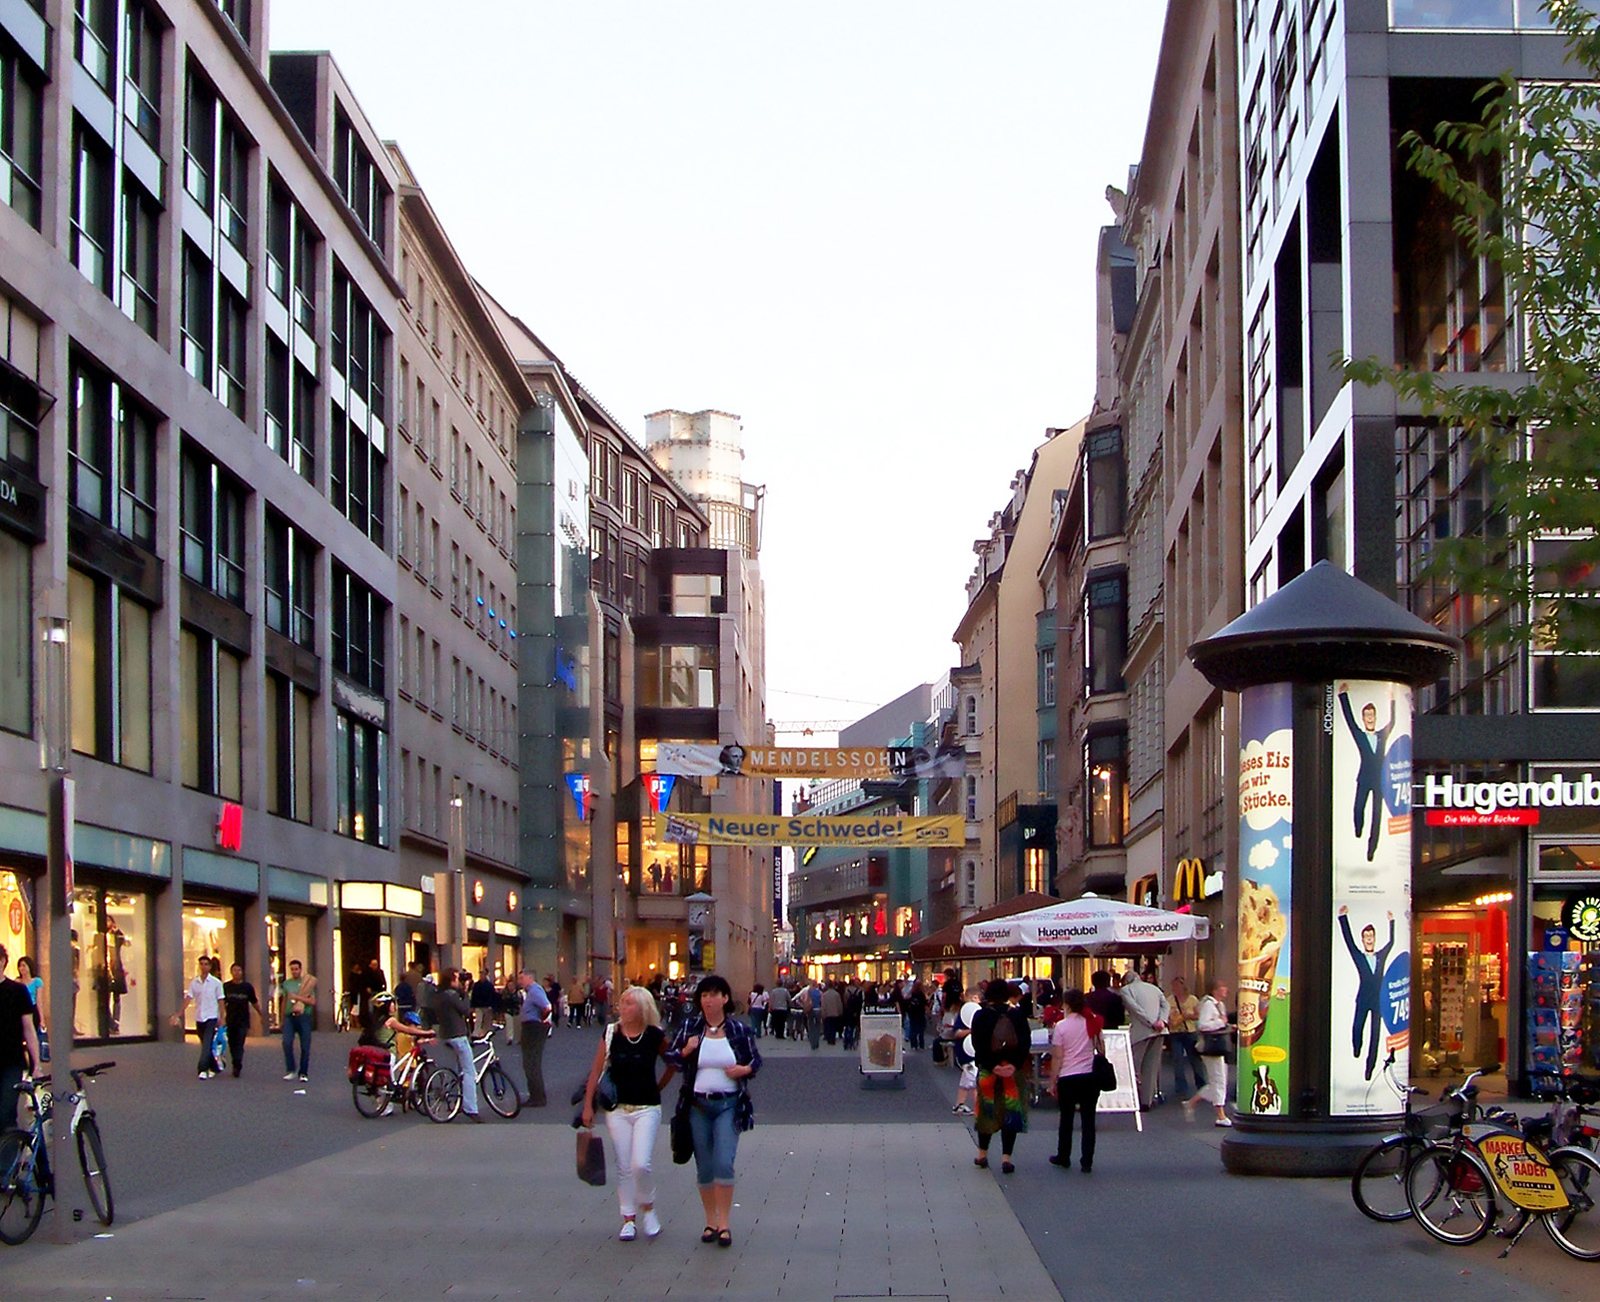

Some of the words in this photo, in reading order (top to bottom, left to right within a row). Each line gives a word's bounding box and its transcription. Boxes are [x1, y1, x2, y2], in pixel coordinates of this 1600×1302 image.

[1323, 684, 1333, 735] JCDecaux
[751, 750, 906, 767] MENDELSSOHN
[1266, 751, 1290, 769] Eis
[1251, 772, 1270, 787] wir
[1243, 791, 1291, 812] Stücke.
[708, 817, 779, 836] Neuer
[788, 818, 904, 837] Schwede!
[1444, 815, 1457, 823] Die
[1460, 815, 1477, 823] Welt
[1478, 815, 1492, 824] der
[1494, 815, 1520, 824] Bücher
[978, 928, 1011, 938] Hugendubel
[1038, 925, 1098, 939] Hugendubel
[1128, 922, 1179, 934] Hugendubel
